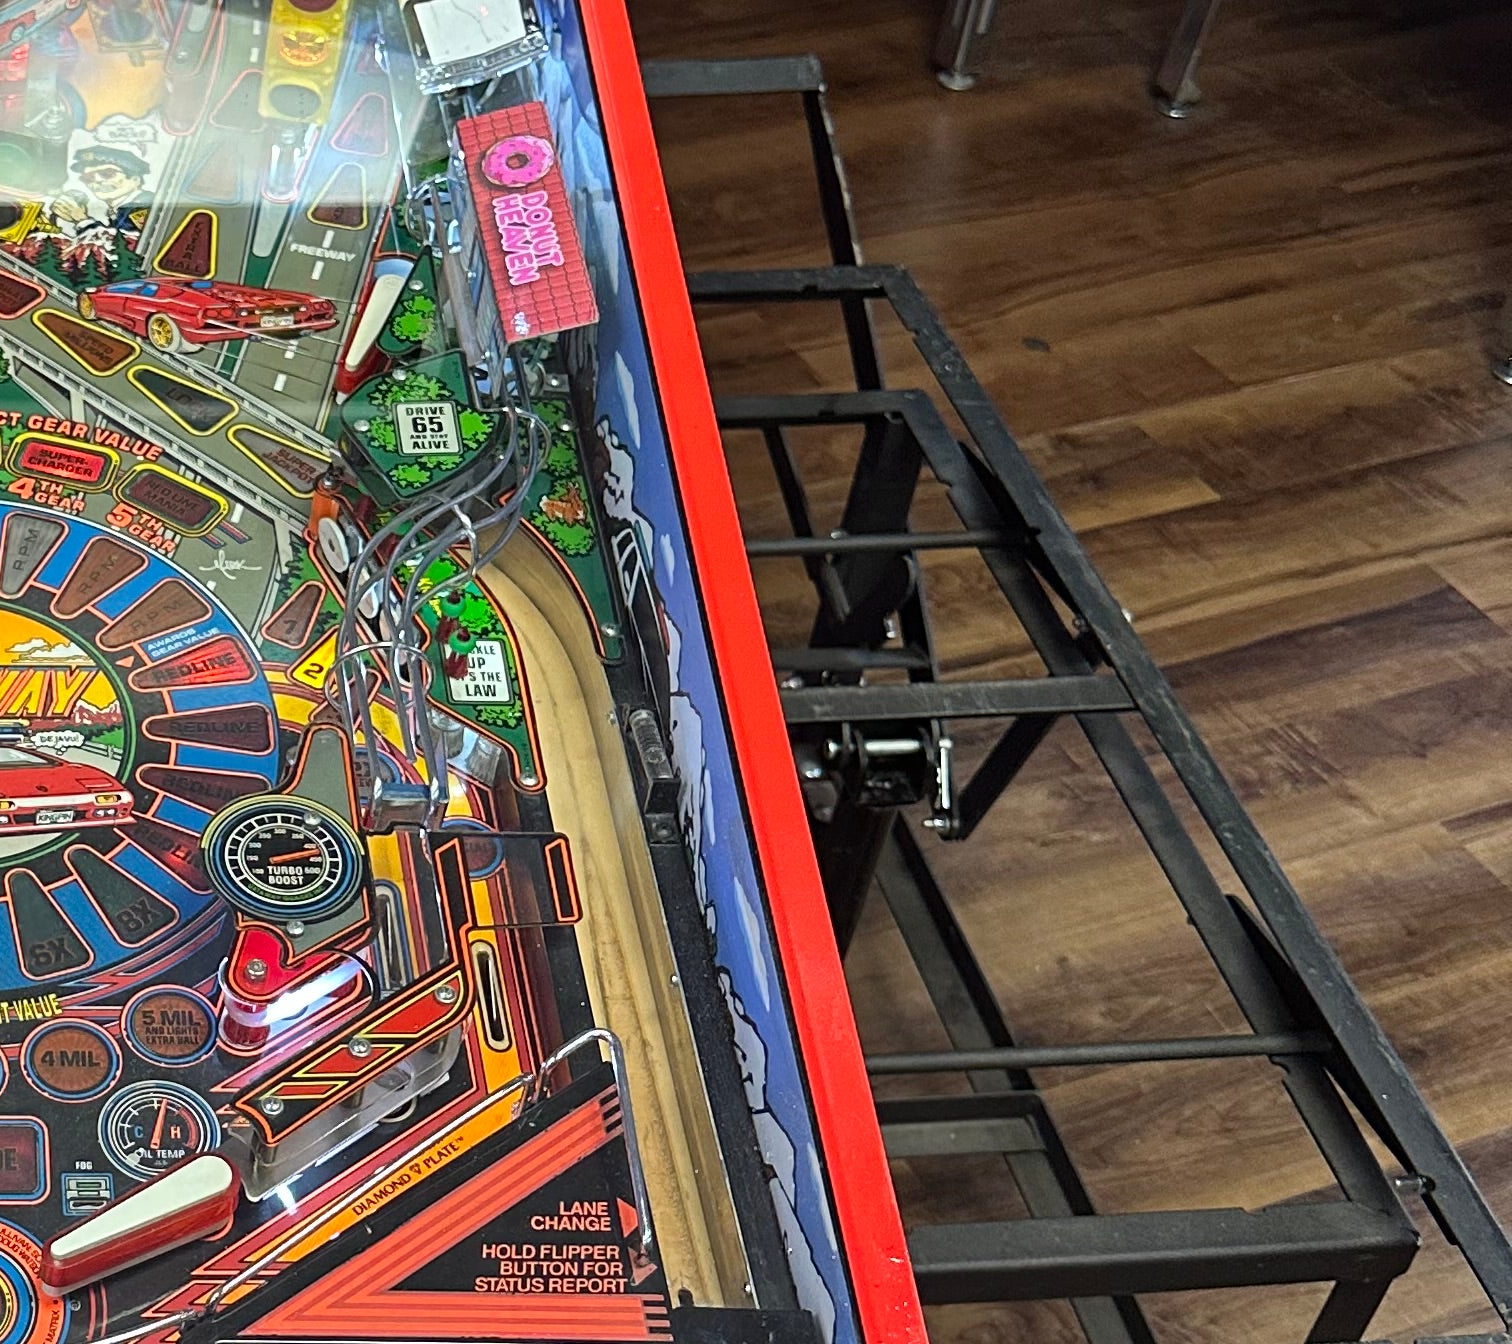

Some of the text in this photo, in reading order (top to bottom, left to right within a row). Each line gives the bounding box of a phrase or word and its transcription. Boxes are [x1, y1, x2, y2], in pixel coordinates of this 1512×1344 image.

[521, 189, 565, 269] DONUT
[492, 193, 541, 287] HEAVEN
[290, 243, 357, 263] FREEWAY
[405, 406, 446, 417] DRIVE
[411, 416, 445, 434] 65
[27, 415, 89, 439] GEAR
[93, 427, 165, 463] VALUE
[412, 439, 451, 450] ALIVE
[27, 456, 93, 478] CHARGER
[7, 477, 86, 513] 4TH GEAR
[105, 501, 178, 554] 5TH GEAR
[13, 526, 40, 572] RPM
[147, 628, 196, 651] AWARDS
[184, 627, 221, 648] VALUE
[152, 652, 237, 683] REDLINE
[481, 671, 501, 682] THE
[466, 684, 497, 697] LAW
[168, 721, 261, 734] REDLINE
[267, 865, 304, 876] TURBO
[268, 874, 304, 886] BOOST
[12, 992, 63, 1021] VALUE
[142, 1010, 202, 1027] 5 MIL
[41, 1050, 101, 1068] 4 MIL
[157, 1149, 185, 1159] TEMP
[351, 1173, 411, 1217] DIAMOND
[559, 1200, 609, 1217] LANE
[530, 1216, 612, 1232] CHANGE
[482, 1243, 621, 1261] HOLD FLIPPER
[500, 1261, 624, 1277] BUTTON FOR
[474, 1277, 629, 1294] STATUS REPORT
